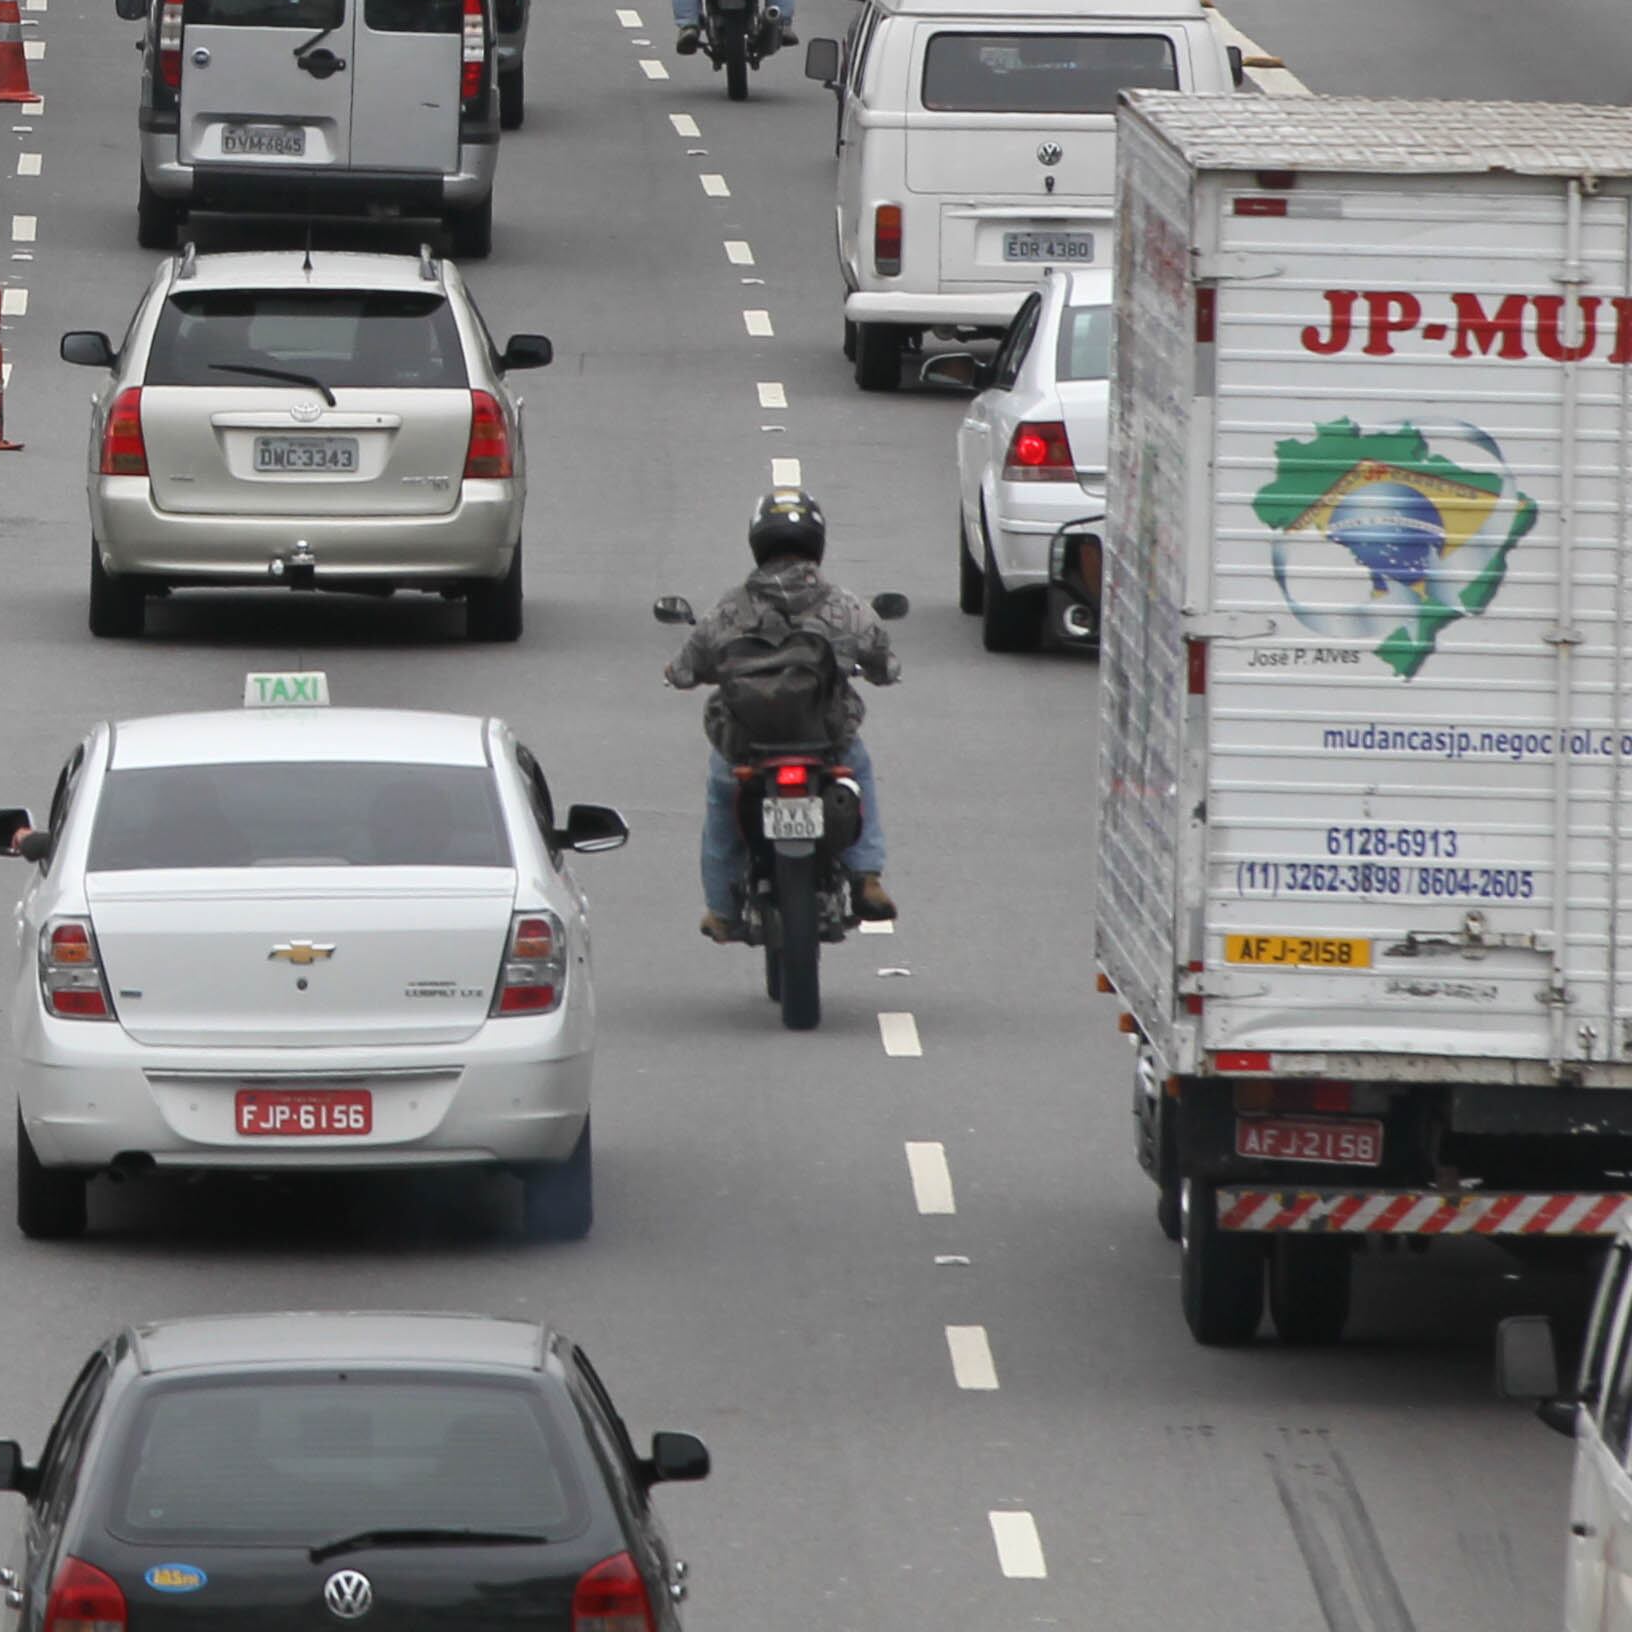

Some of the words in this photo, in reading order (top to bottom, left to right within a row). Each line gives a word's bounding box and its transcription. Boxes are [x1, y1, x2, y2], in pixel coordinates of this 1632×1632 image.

[254, 676, 318, 701] TAXI
[1327, 827, 1458, 858] 6128-6913
[1237, 861, 1279, 896] (11)
[1286, 864, 1401, 894] 3262-3898
[1418, 869, 1533, 898] 8604-2605
